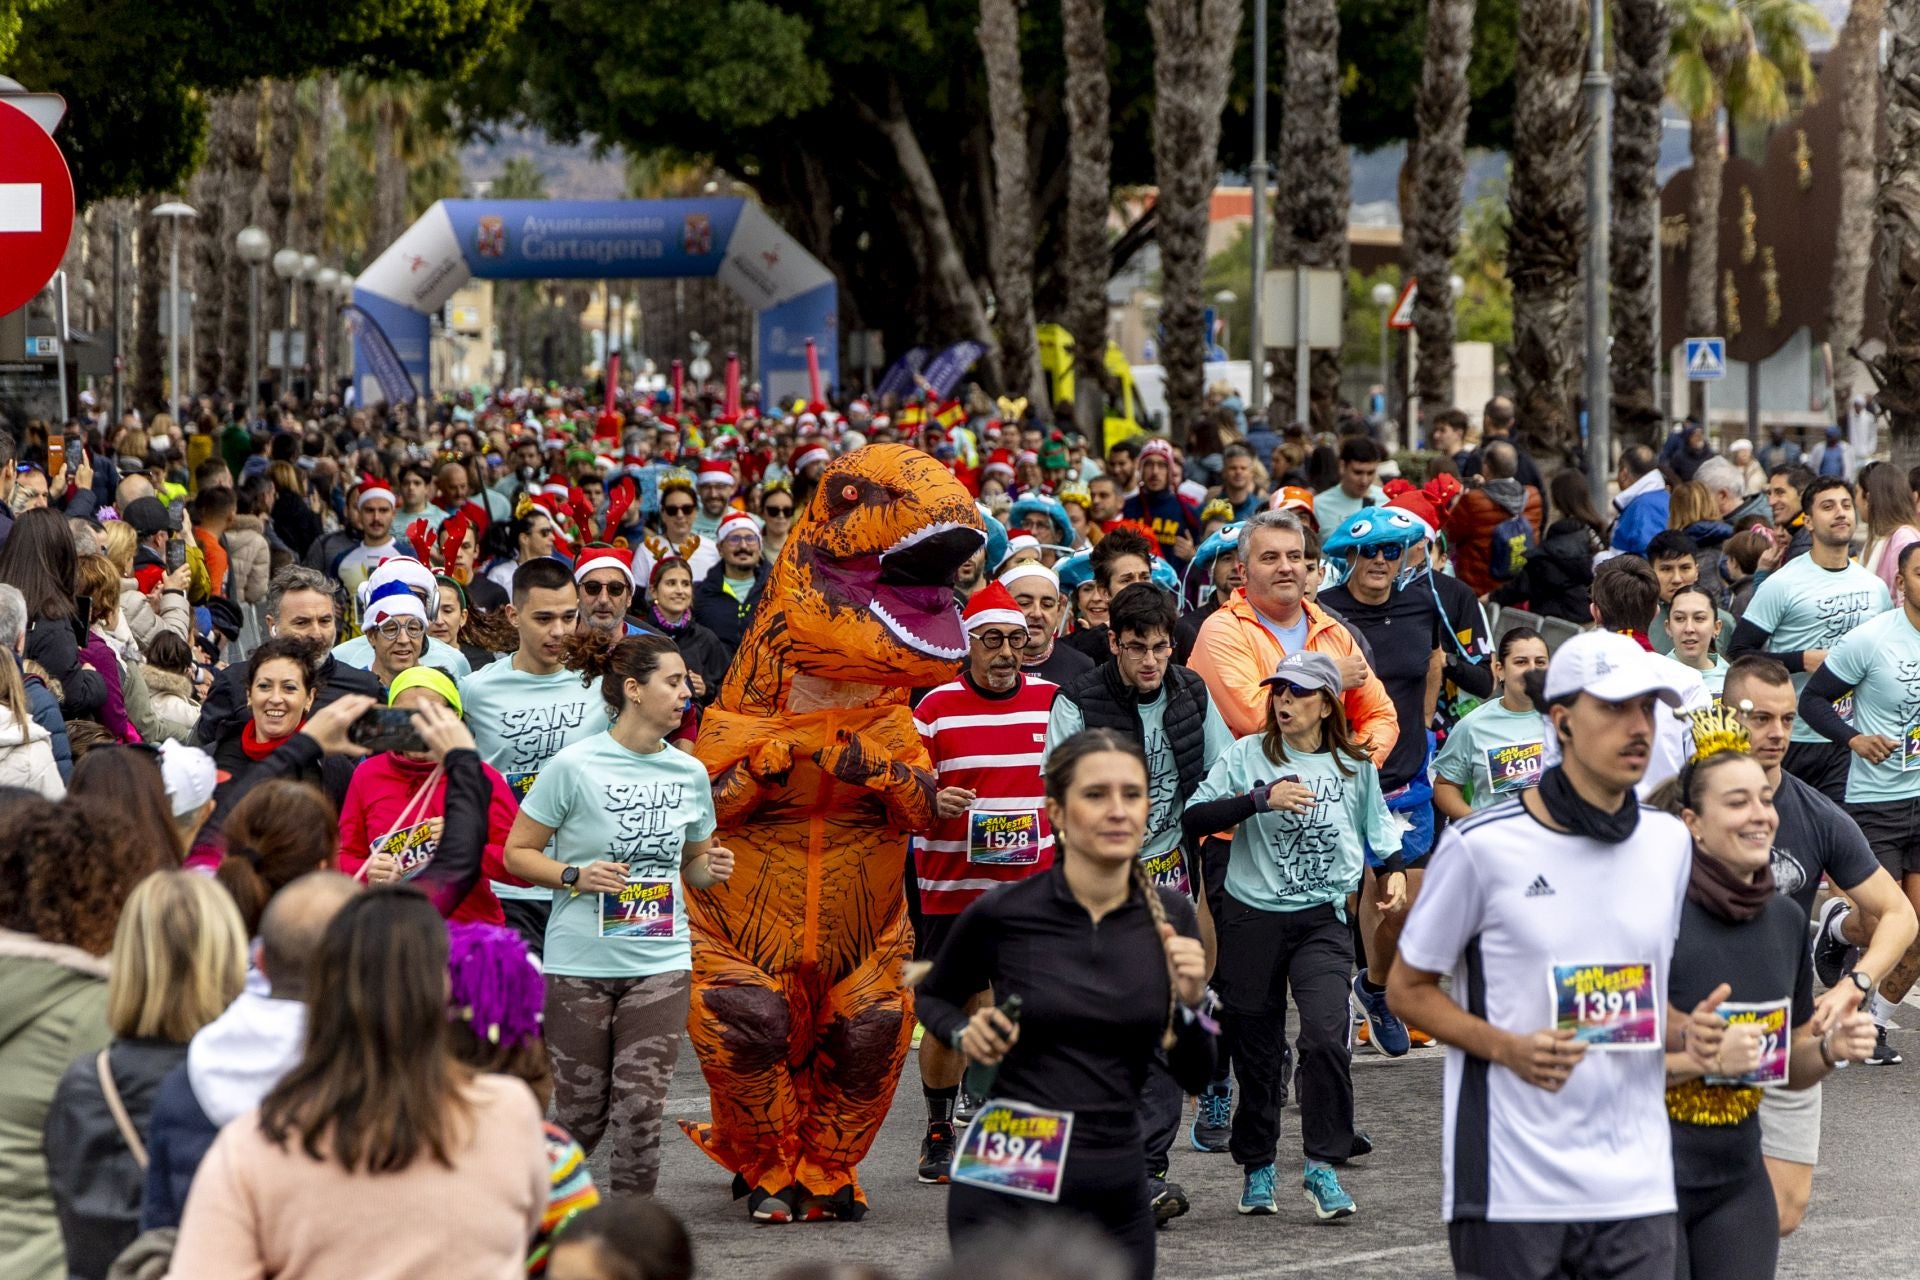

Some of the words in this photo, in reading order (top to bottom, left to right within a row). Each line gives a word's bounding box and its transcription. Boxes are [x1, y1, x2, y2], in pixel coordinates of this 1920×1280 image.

[523, 215, 665, 236] Ayuntamiento
[521, 233, 665, 265] Cartagena
[1815, 591, 1870, 620] SAN
[499, 702, 586, 739] SAN
[1505, 757, 1538, 777] 630
[603, 782, 684, 813] SAN
[614, 810, 673, 841] SIL
[986, 817, 1008, 828] SAN
[986, 815, 1033, 833] SILVESTRE
[983, 830, 1029, 849] 1528
[1270, 829, 1340, 859] VES
[618, 883, 671, 903] SILVESTRE
[622, 900, 660, 921] 748
[1574, 991, 1638, 1022] 1391
[975, 1129, 1044, 1170] 1394
